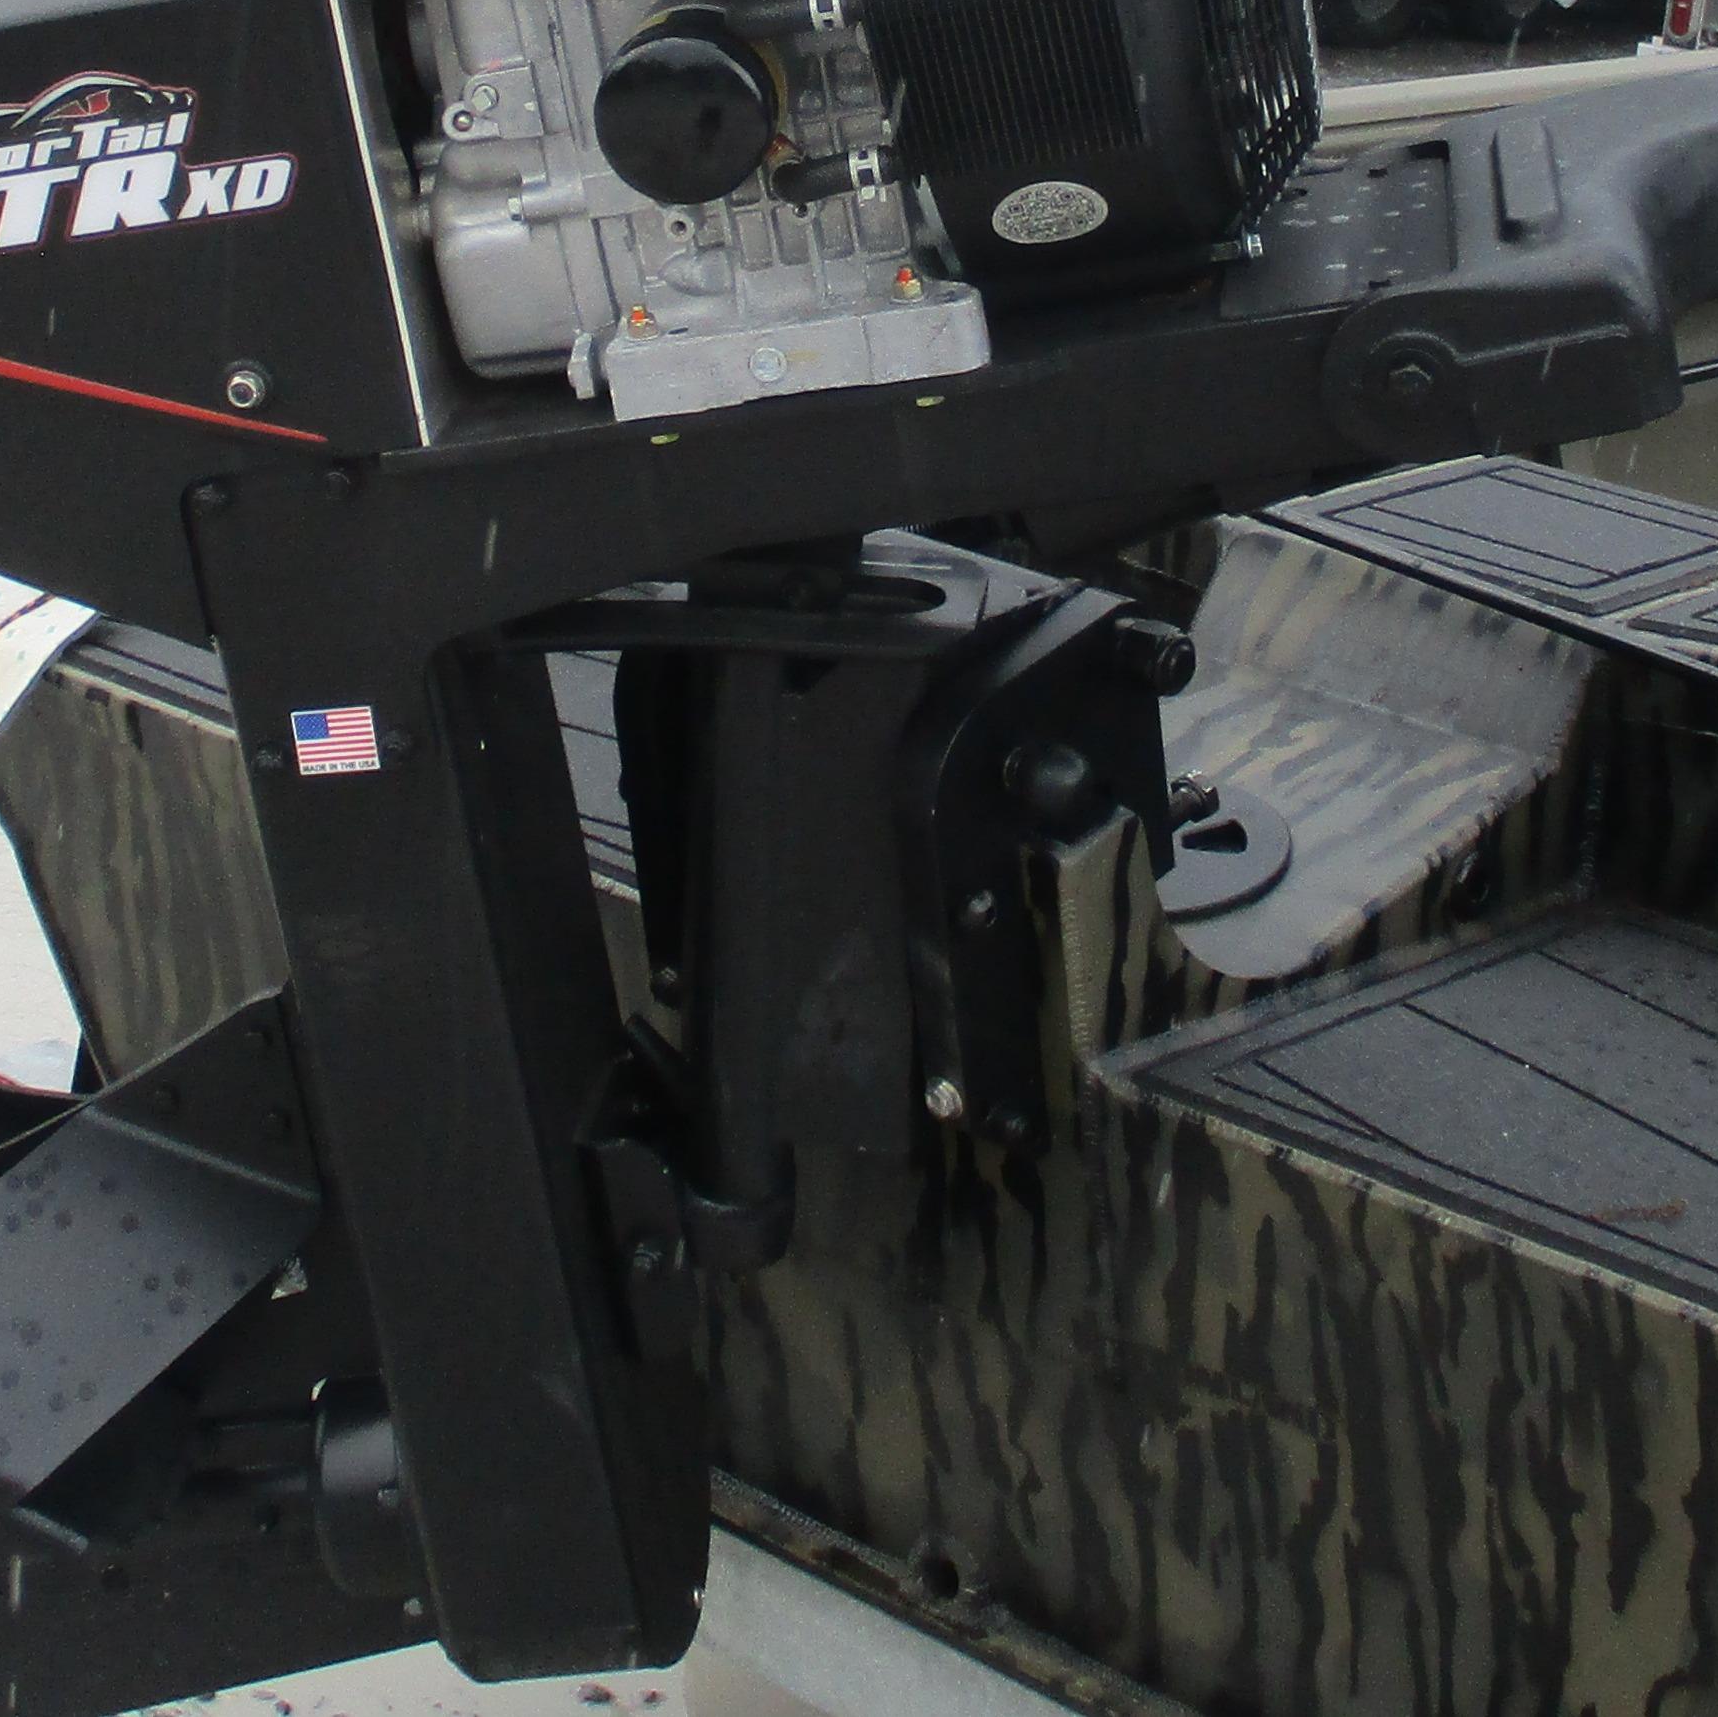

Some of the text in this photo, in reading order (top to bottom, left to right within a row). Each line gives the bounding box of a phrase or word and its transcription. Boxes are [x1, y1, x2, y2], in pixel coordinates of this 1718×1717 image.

[176, 158, 293, 221] XD
[303, 760, 376, 772] MADE IN THE USA
